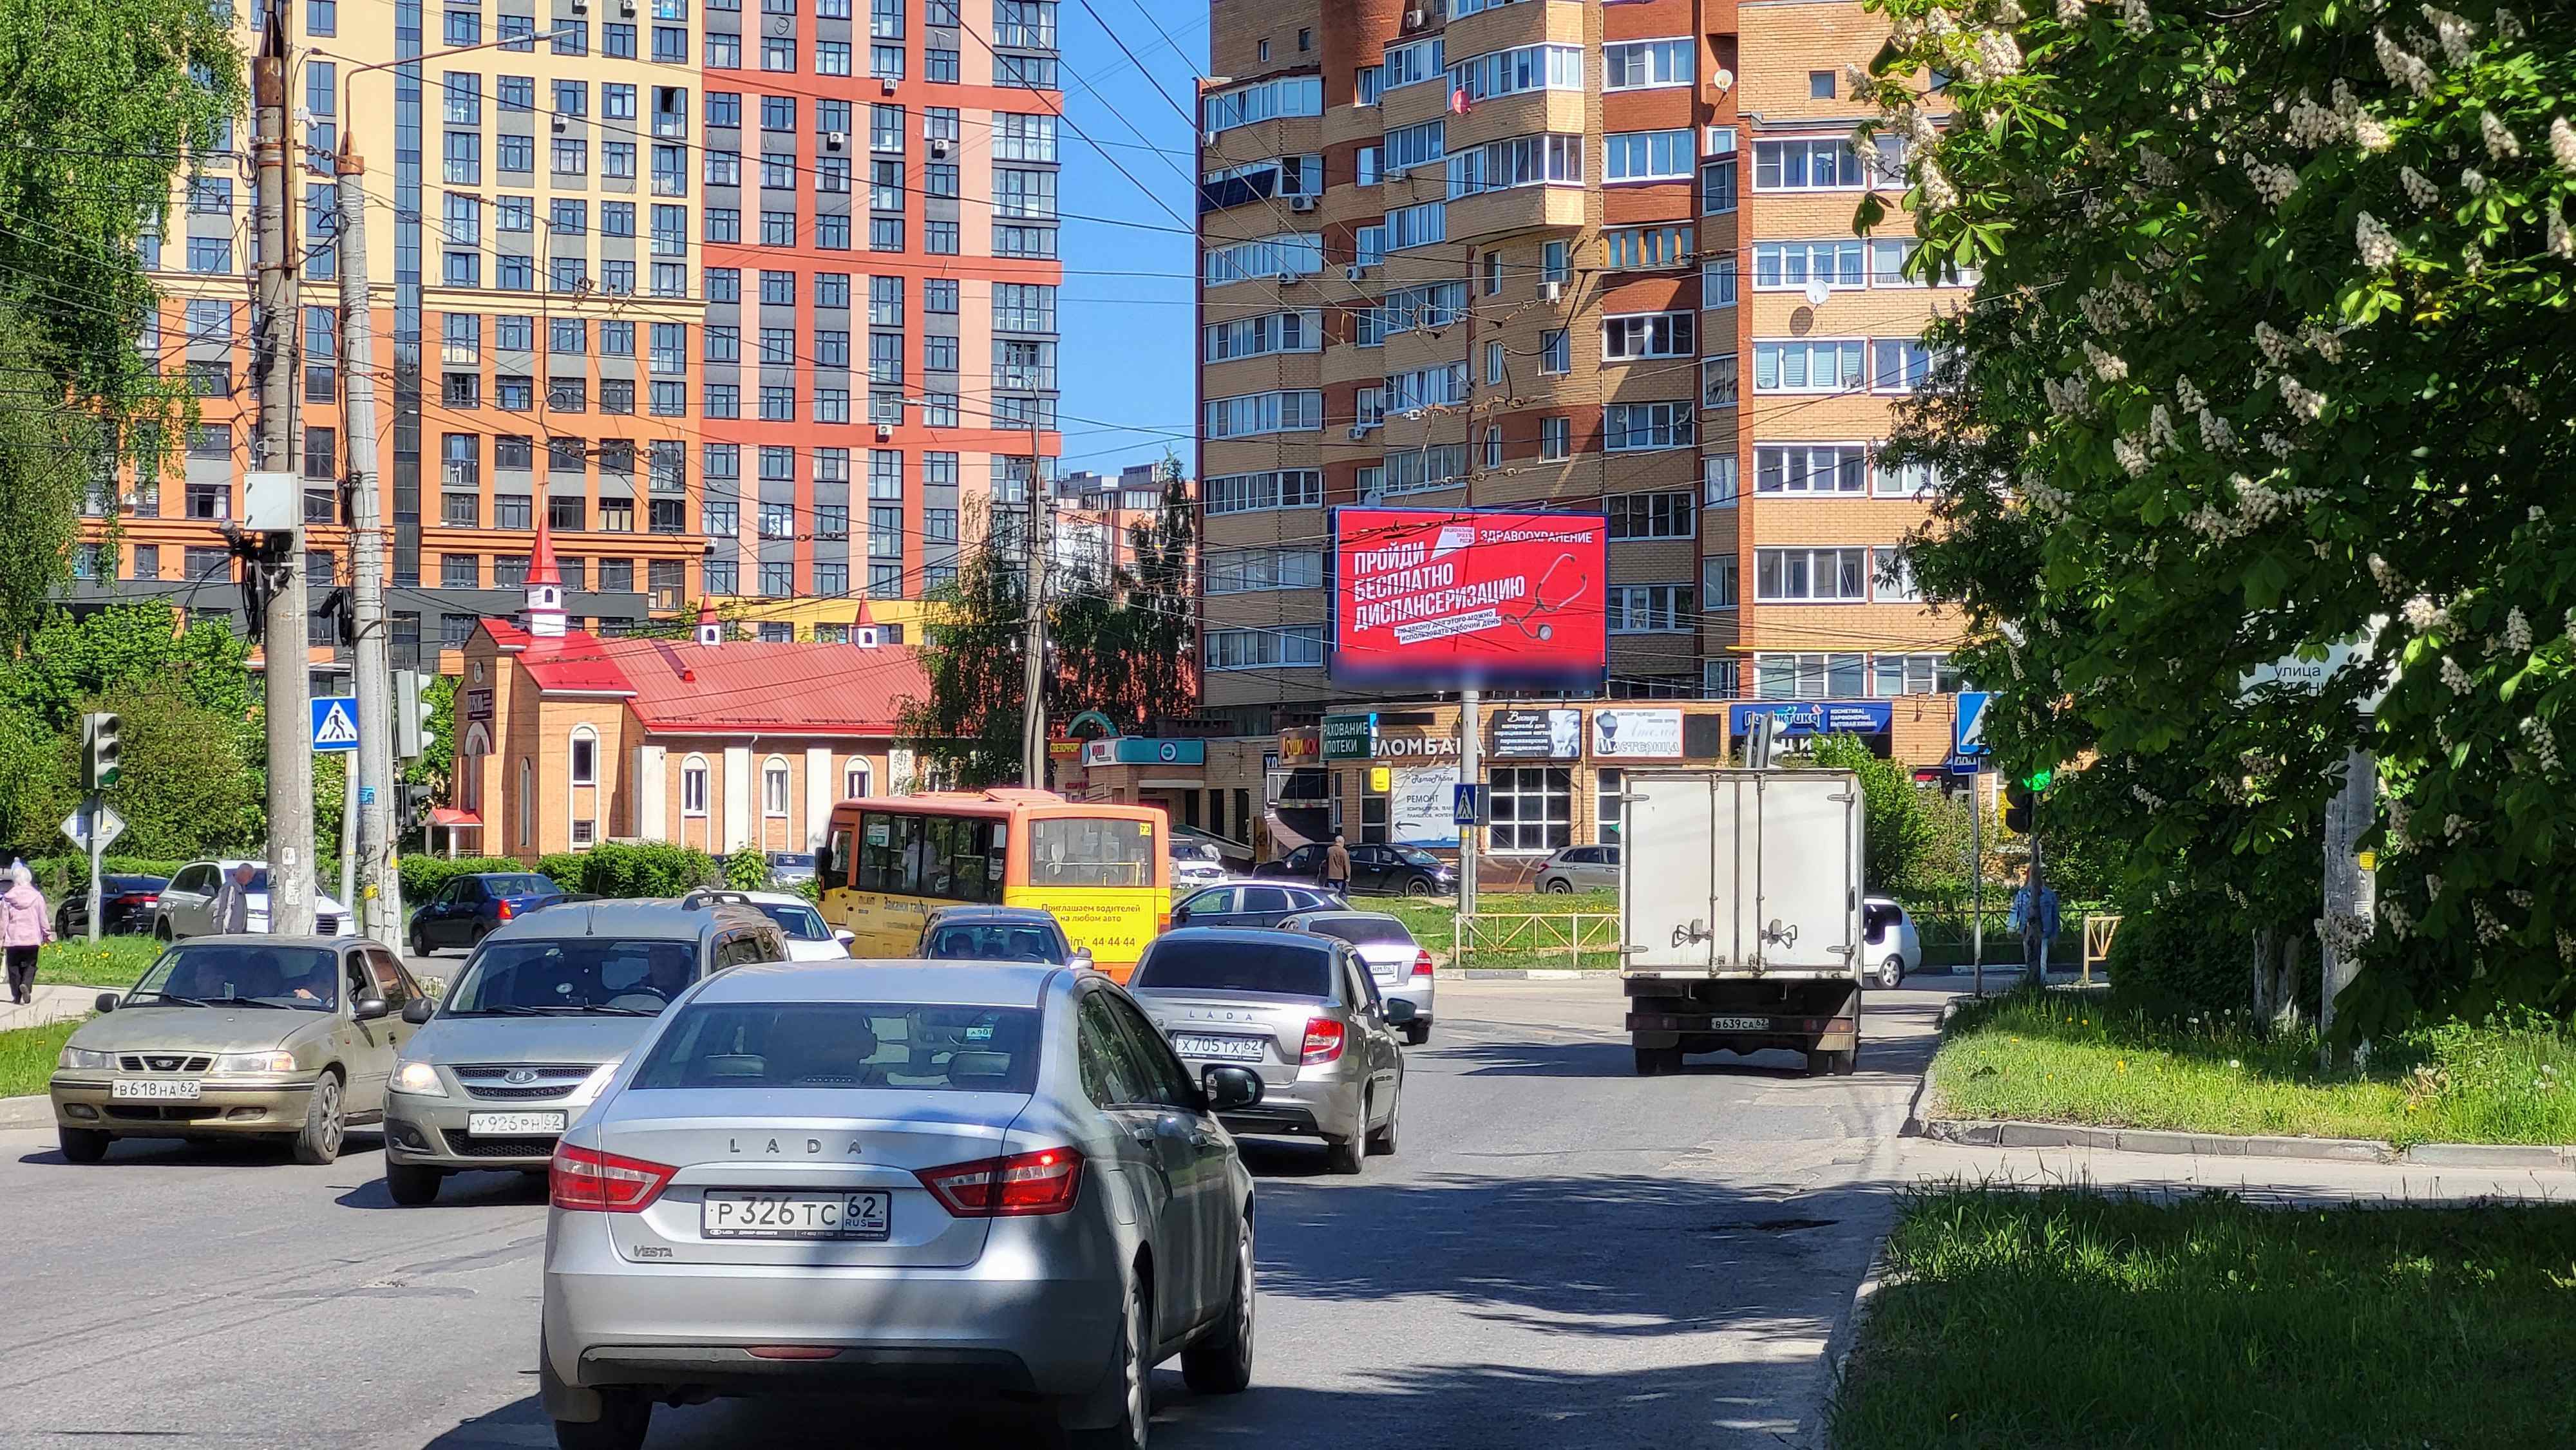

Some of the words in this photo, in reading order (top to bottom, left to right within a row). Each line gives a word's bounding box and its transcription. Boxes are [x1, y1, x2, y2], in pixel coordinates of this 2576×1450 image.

[1481, 530, 1593, 543] ЗДРАВООХРАНЕНИЕ
[1354, 541, 1424, 575] ПРОЙДИ
[1354, 563, 1454, 603] БЕСПЛАТНО
[1354, 576, 1525, 632] ДИСПАНСЕРИЗАЦИЮ
[1401, 628, 1448, 642] использовать
[1482, 617, 1500, 627] день
[2275, 666, 2321, 679] улица
[1323, 739, 1358, 753] ИПОТЕКИ
[1596, 739, 1680, 755] Мастерица
[1406, 795, 1439, 804] РЕМОНТ
[1042, 903, 1094, 913] Приглашаем
[1096, 904, 1141, 914] водителей
[1072, 914, 1101, 922] любом
[1189, 1010, 1253, 1021] LADA
[730, 1138, 862, 1154] LADA
[847, 1196, 876, 1218] 62
[845, 1218, 867, 1227] RUS
